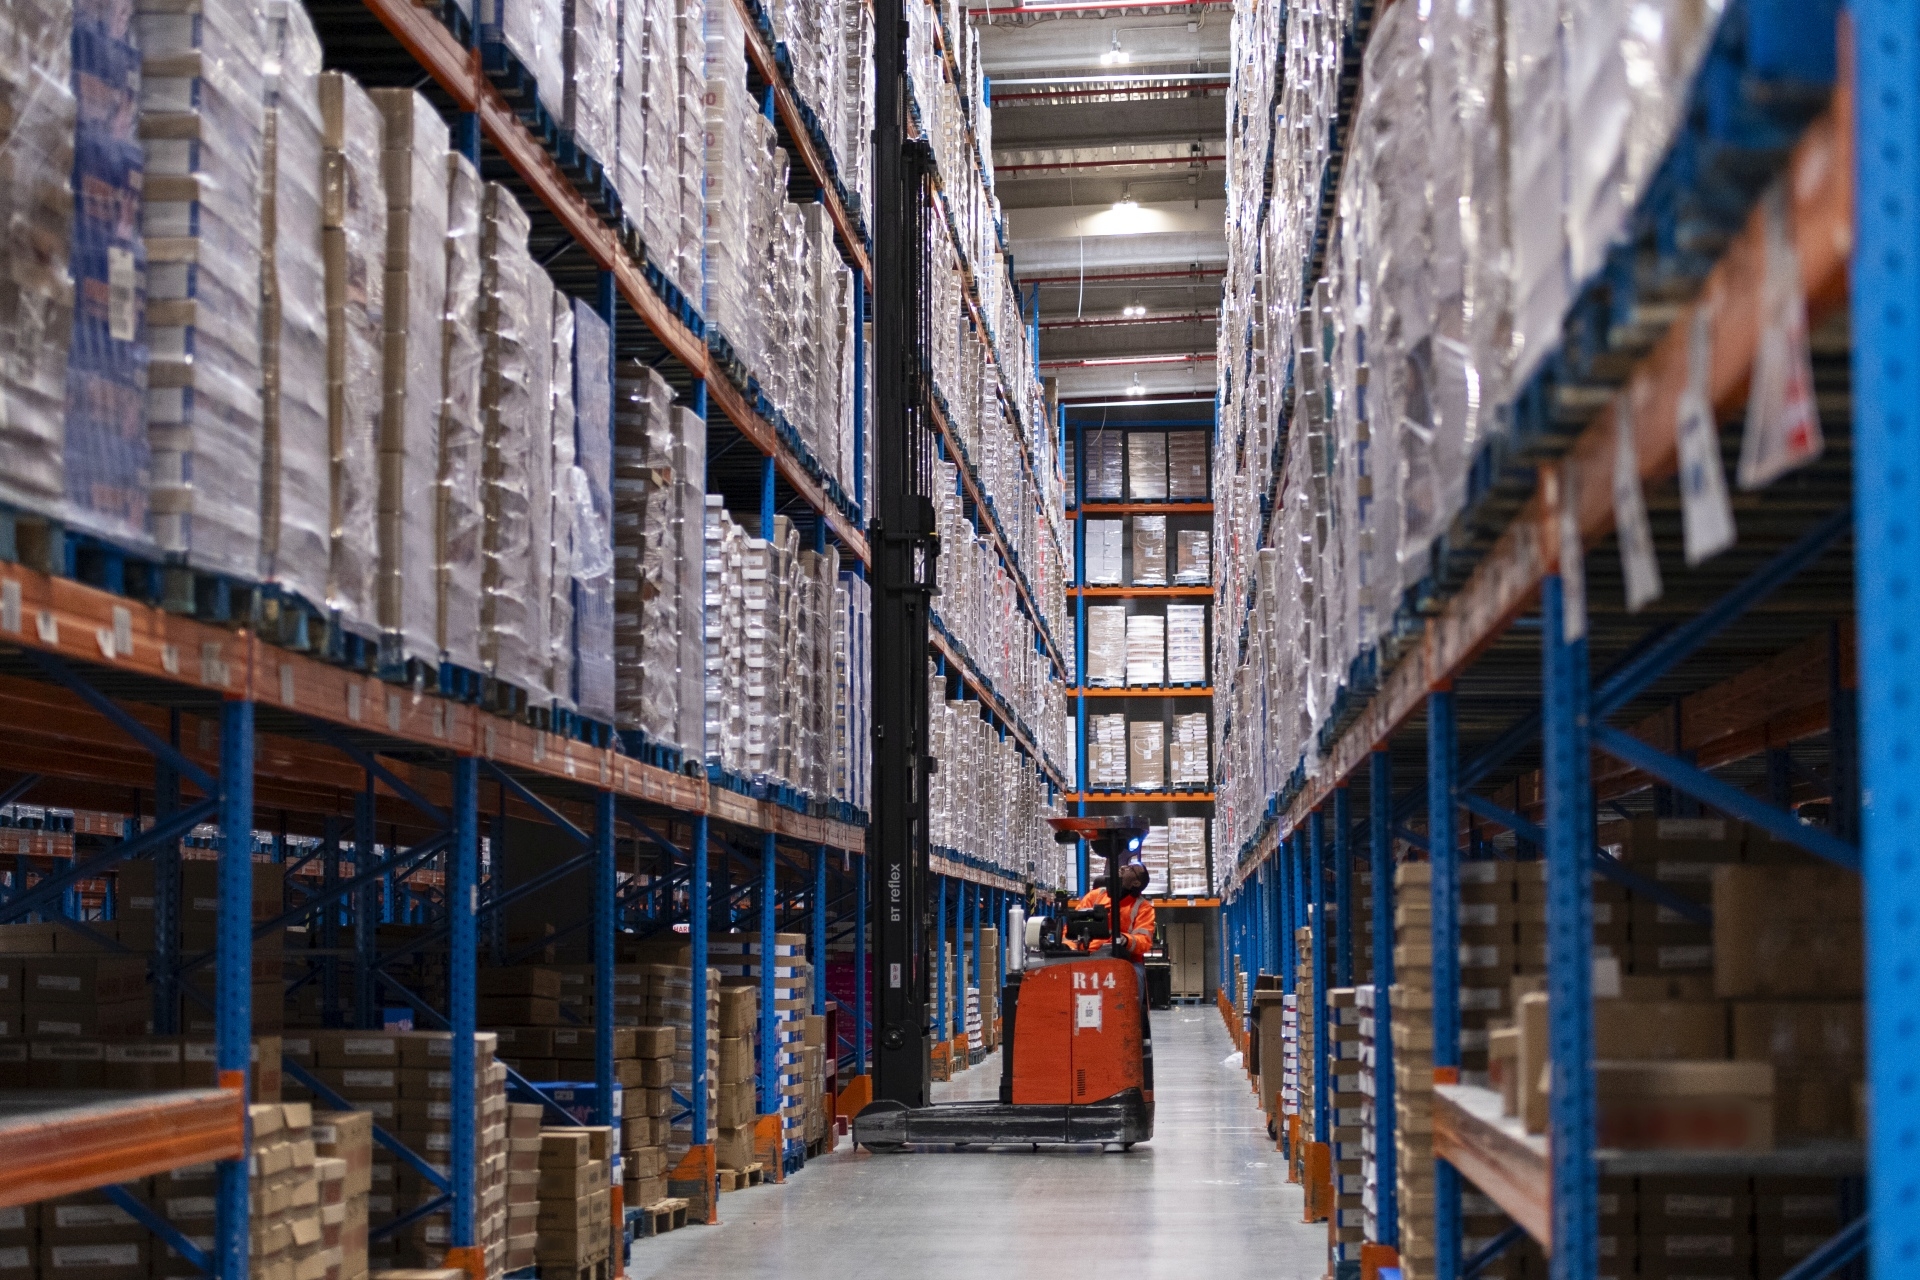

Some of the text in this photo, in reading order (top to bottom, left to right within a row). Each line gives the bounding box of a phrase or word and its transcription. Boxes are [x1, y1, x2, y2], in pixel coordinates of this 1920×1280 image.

[888, 863, 901, 922] BT reflex
[1072, 971, 1116, 989] R14
